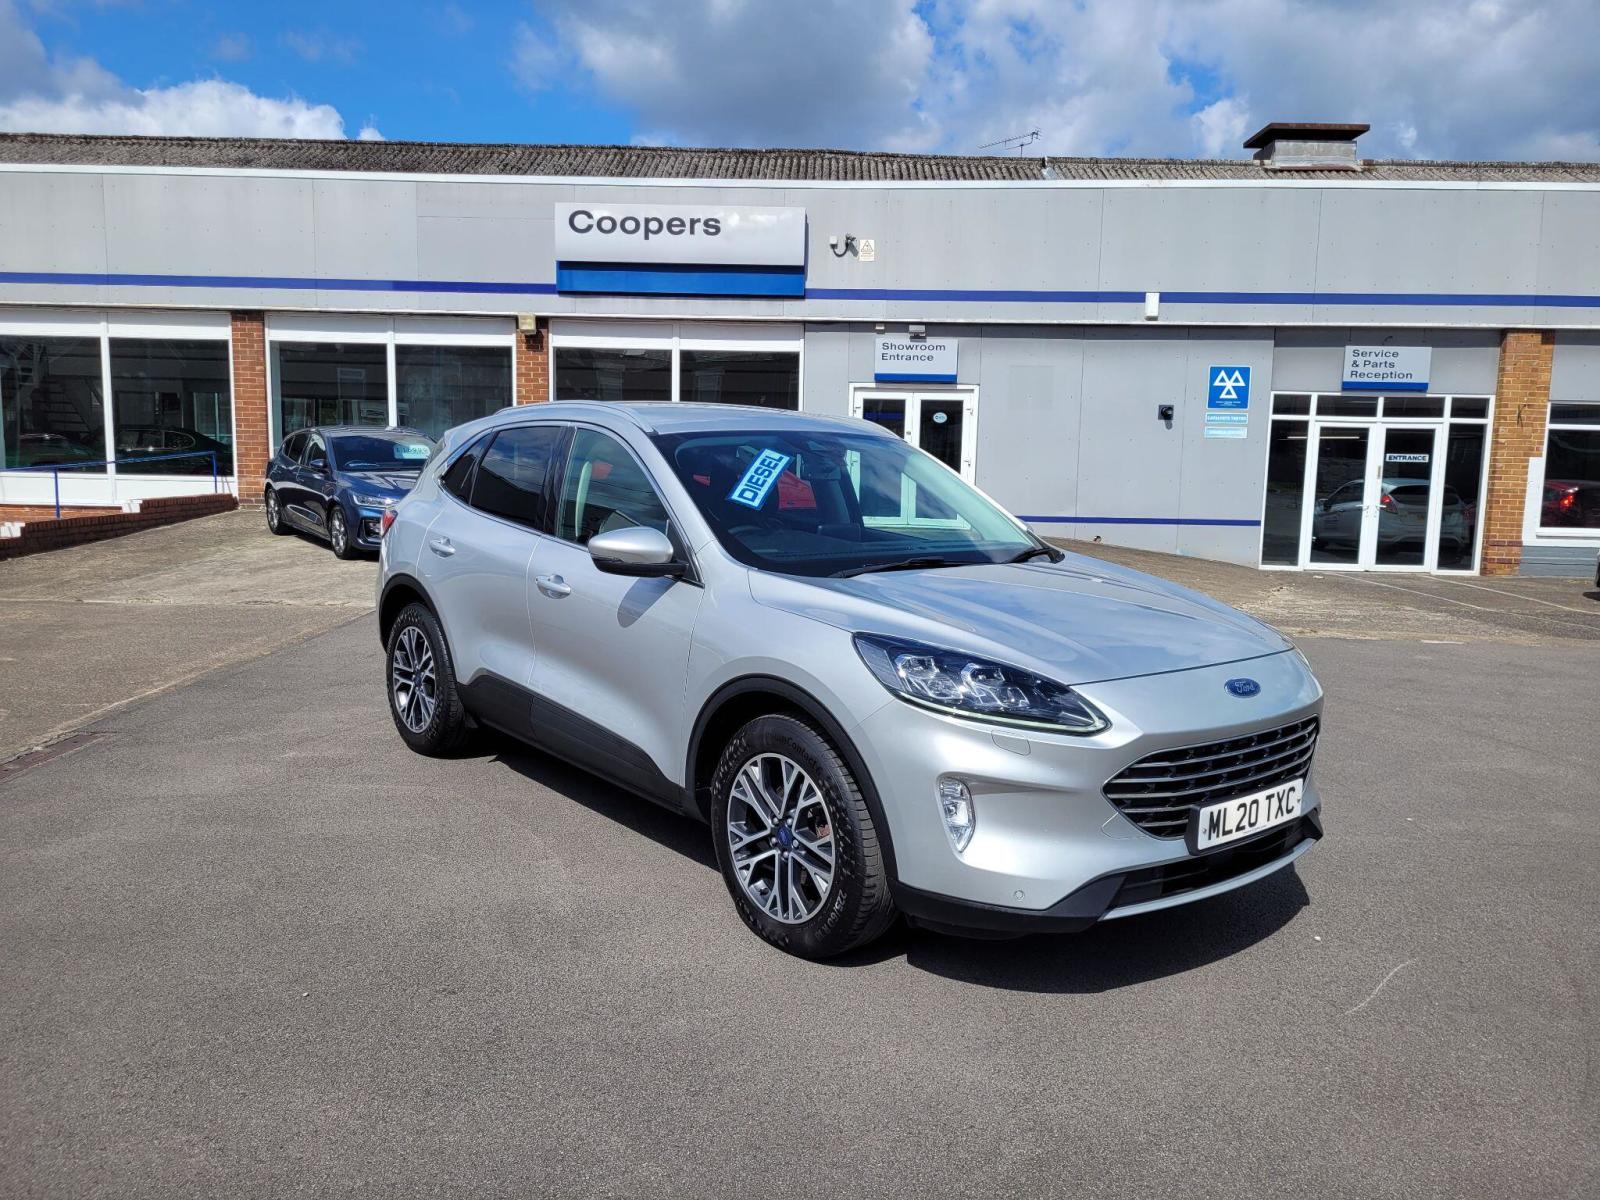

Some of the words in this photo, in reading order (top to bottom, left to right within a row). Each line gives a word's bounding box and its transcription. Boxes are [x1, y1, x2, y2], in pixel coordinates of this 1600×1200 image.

[568, 209, 722, 240] Coopers
[882, 342, 946, 351] Showroom
[881, 352, 934, 361] Entrance
[1352, 349, 1399, 358] Service
[1351, 360, 1360, 368] &
[1363, 360, 1395, 368] Parts
[1350, 370, 1413, 380] Reception
[737, 455, 785, 502] DIESEL
[1208, 799, 1259, 840] ML20
[1265, 786, 1296, 822] TXC
